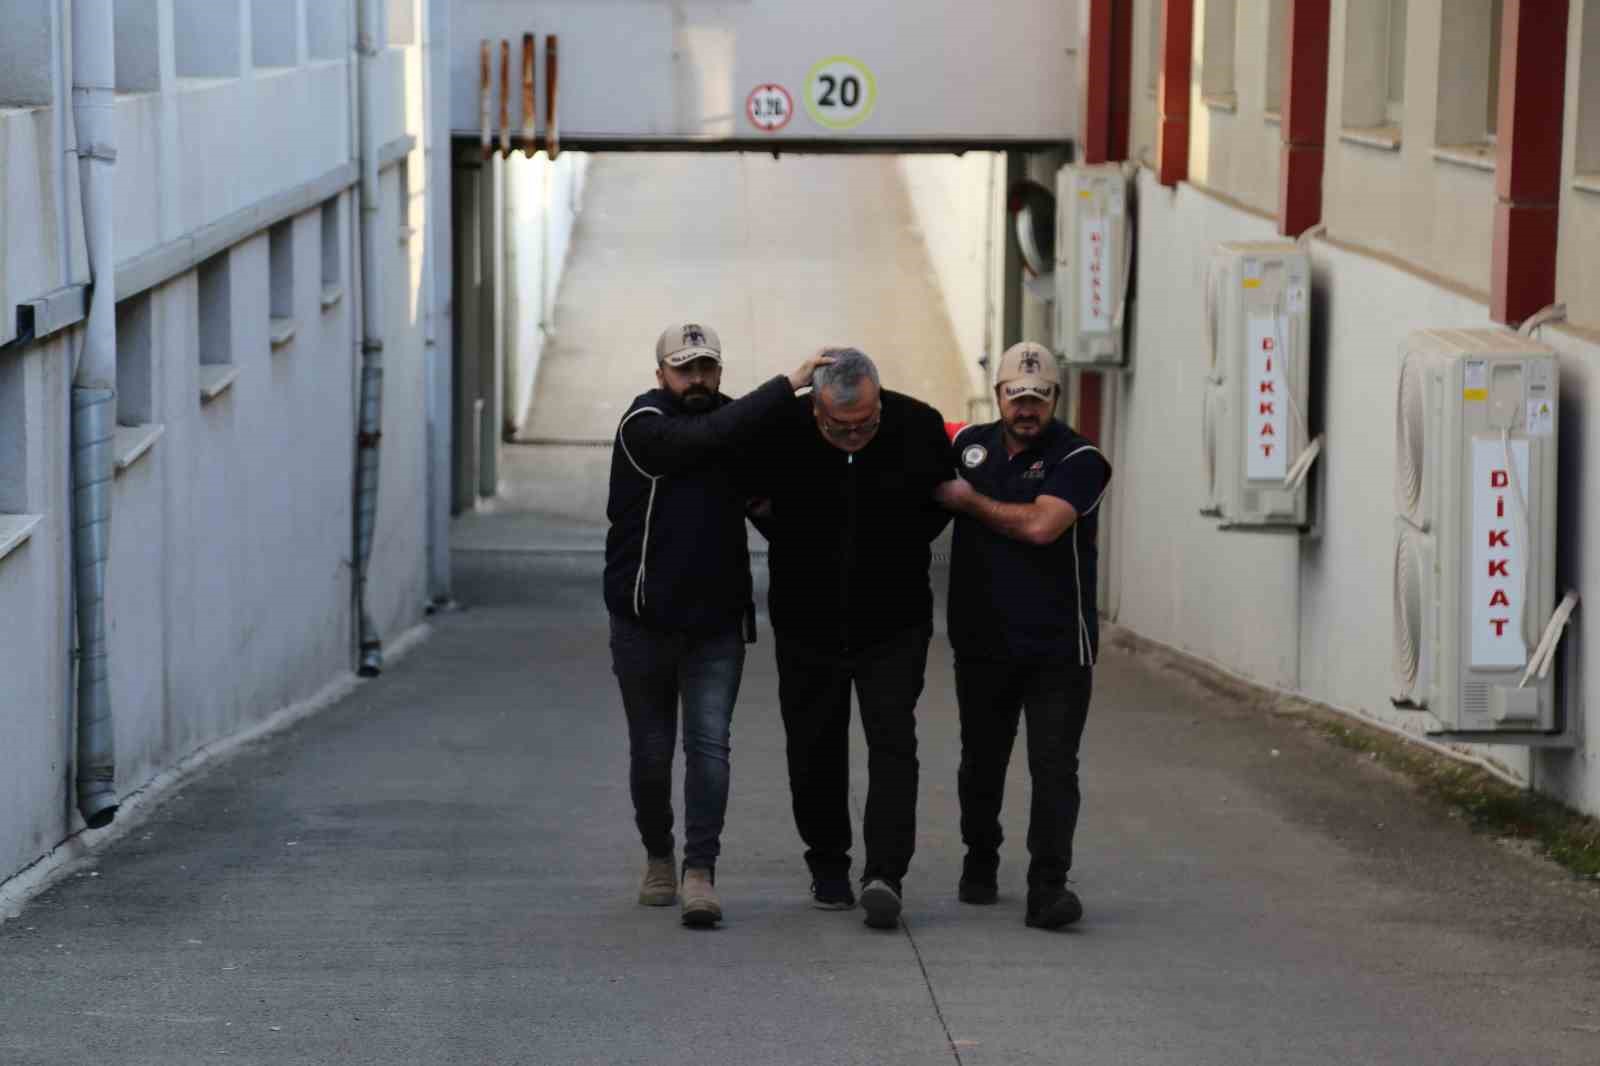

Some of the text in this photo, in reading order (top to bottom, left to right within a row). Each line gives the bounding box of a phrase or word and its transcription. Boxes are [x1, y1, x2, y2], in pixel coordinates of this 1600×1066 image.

[818, 74, 860, 107] 20
[1259, 337, 1275, 458] DİKKAT
[1488, 469, 1510, 639] DİKKAT
